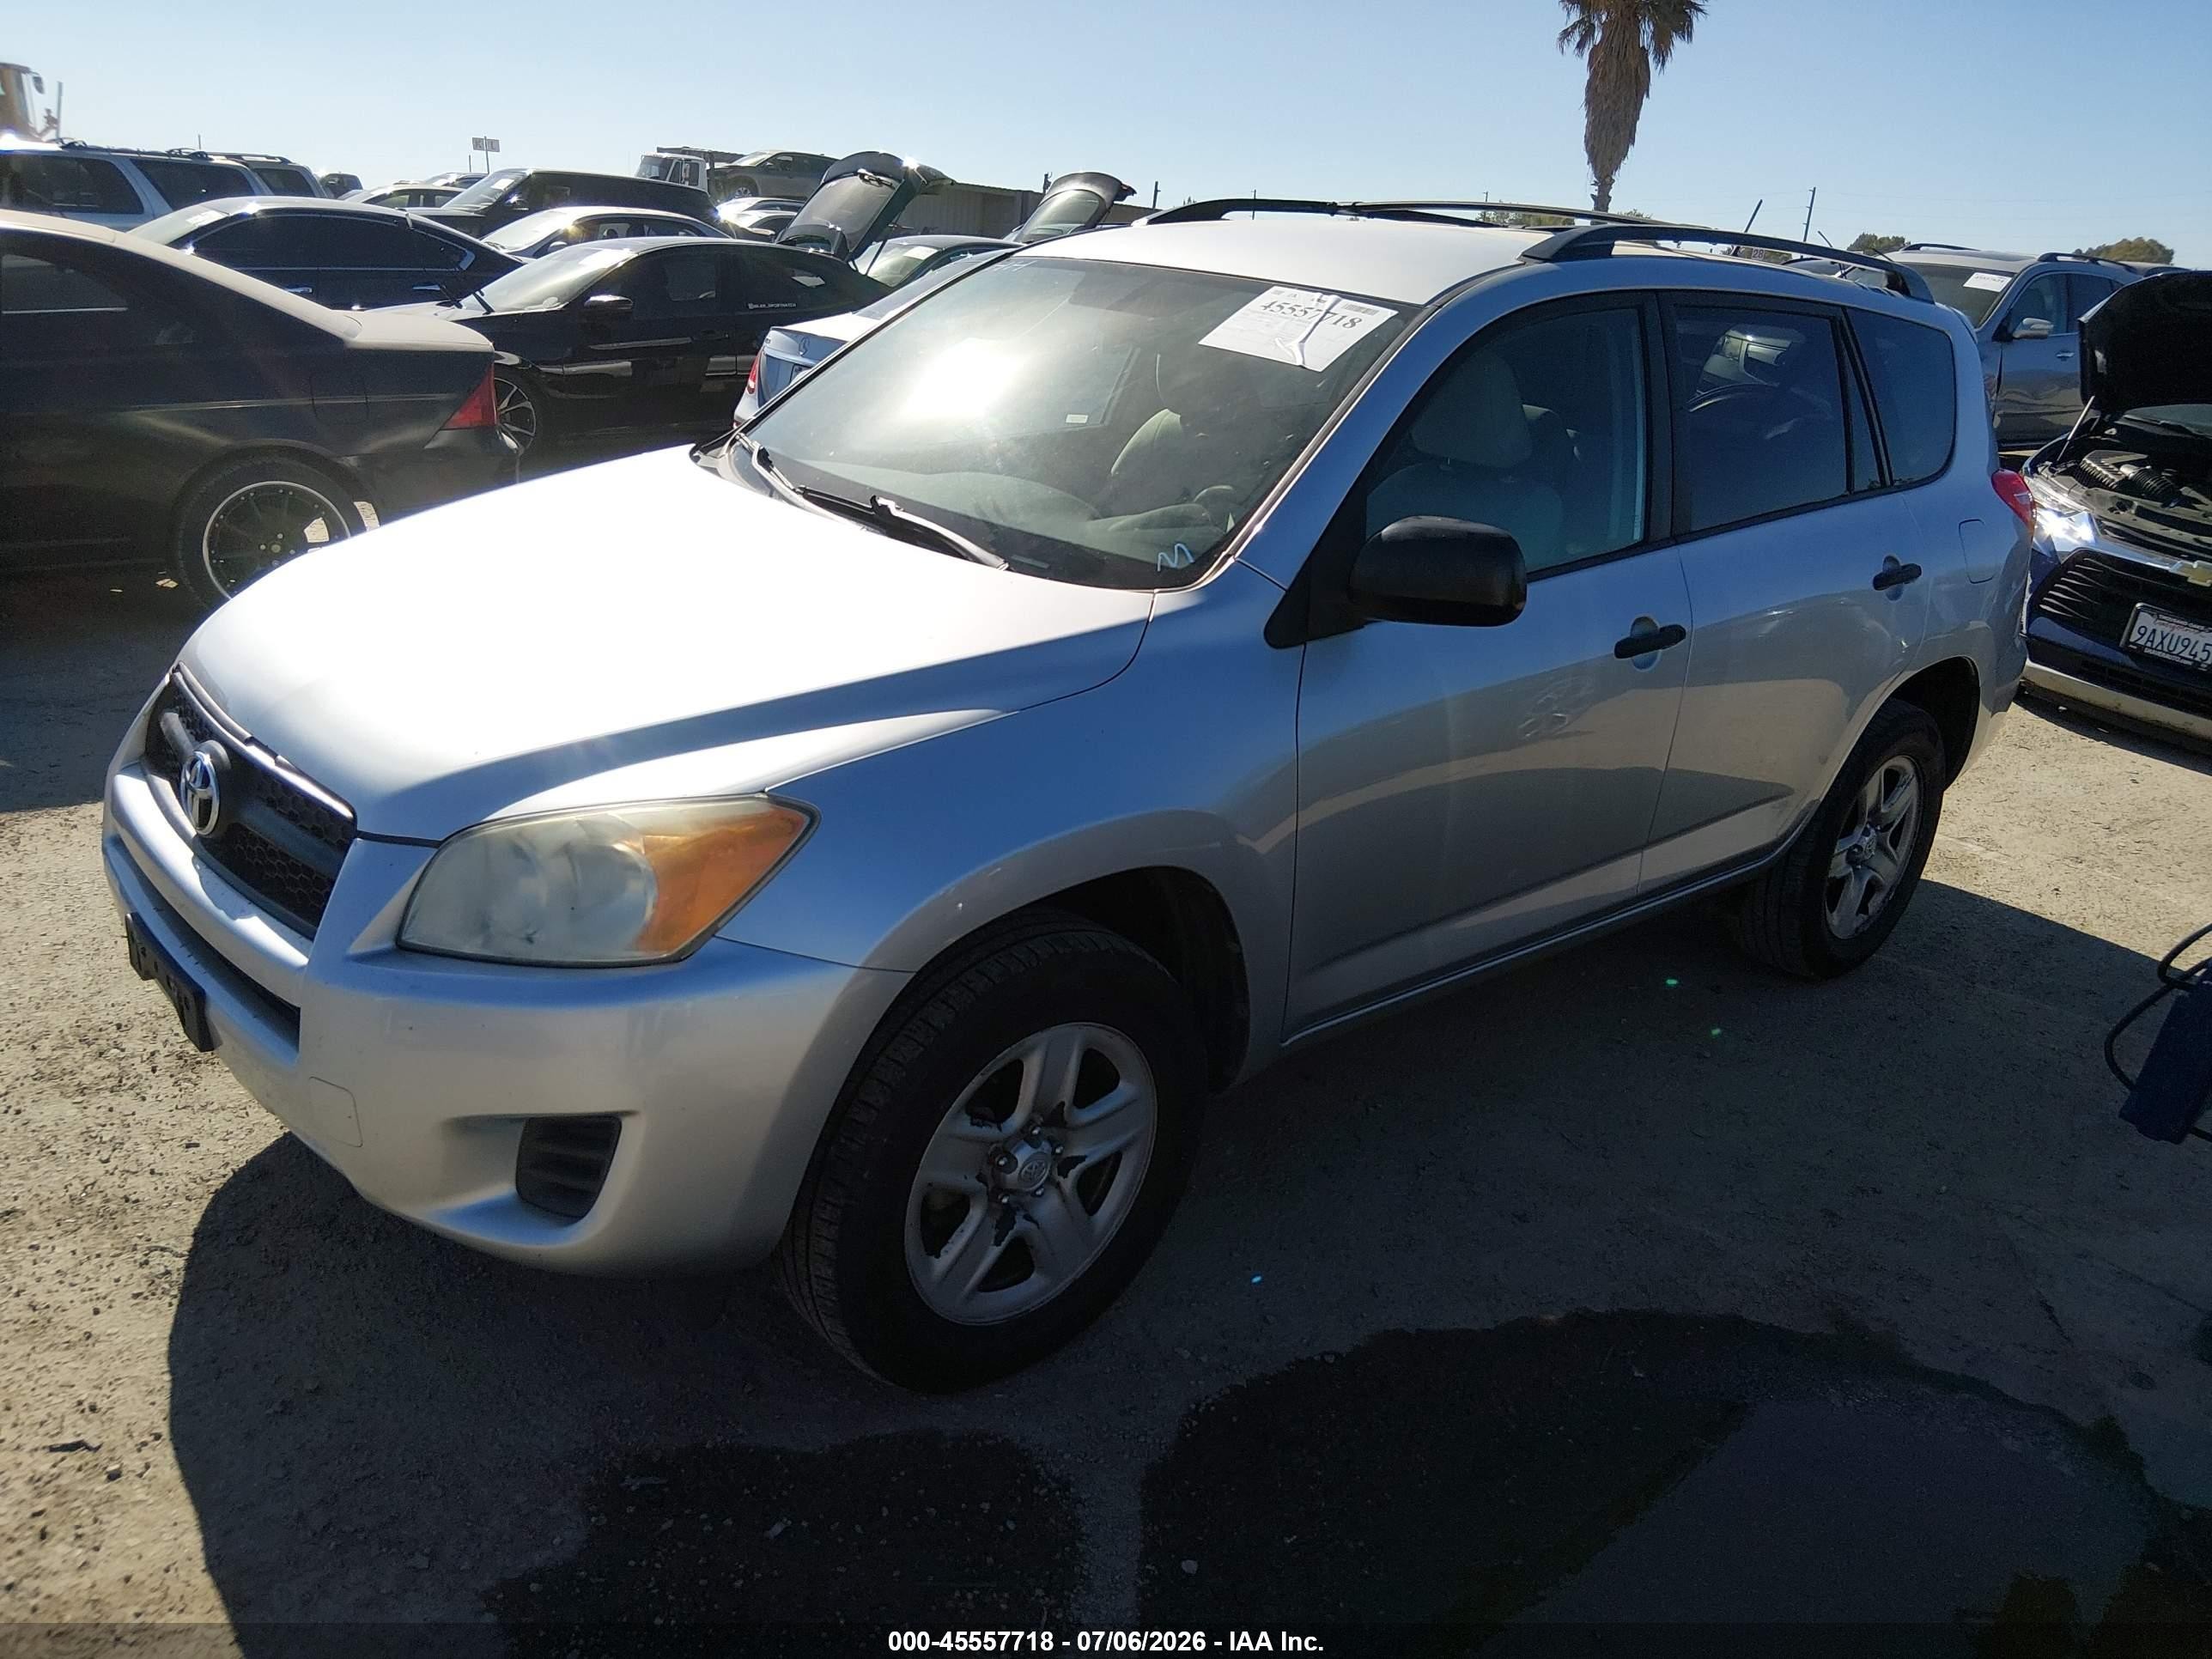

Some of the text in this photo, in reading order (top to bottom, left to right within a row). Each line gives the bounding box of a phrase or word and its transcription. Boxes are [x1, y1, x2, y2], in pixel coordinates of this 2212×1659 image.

[1753, 249, 1764, 258] 28
[1261, 300, 1363, 330] 45557718
[2134, 625, 2212, 662] 9AXU945
